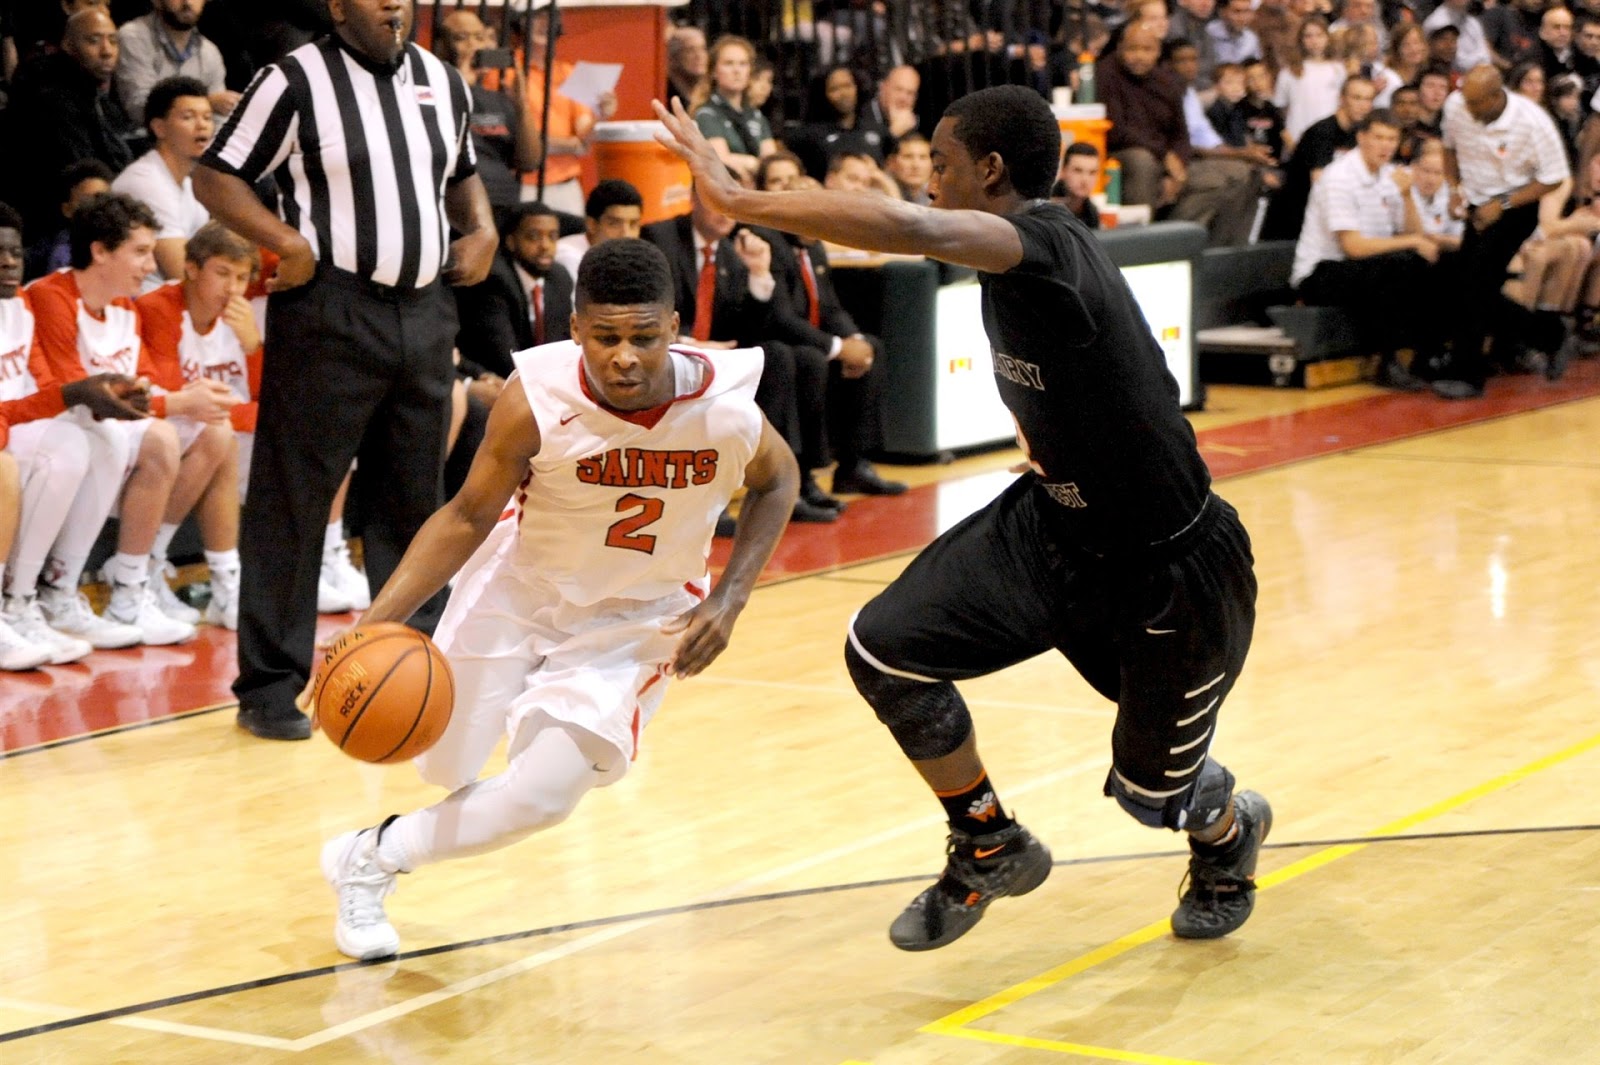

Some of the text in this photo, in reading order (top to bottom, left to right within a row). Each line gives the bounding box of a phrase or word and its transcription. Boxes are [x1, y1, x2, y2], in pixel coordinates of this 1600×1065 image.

[576, 448, 718, 489] SAINTS
[604, 493, 665, 555] 2
[339, 682, 367, 718] ROCK
